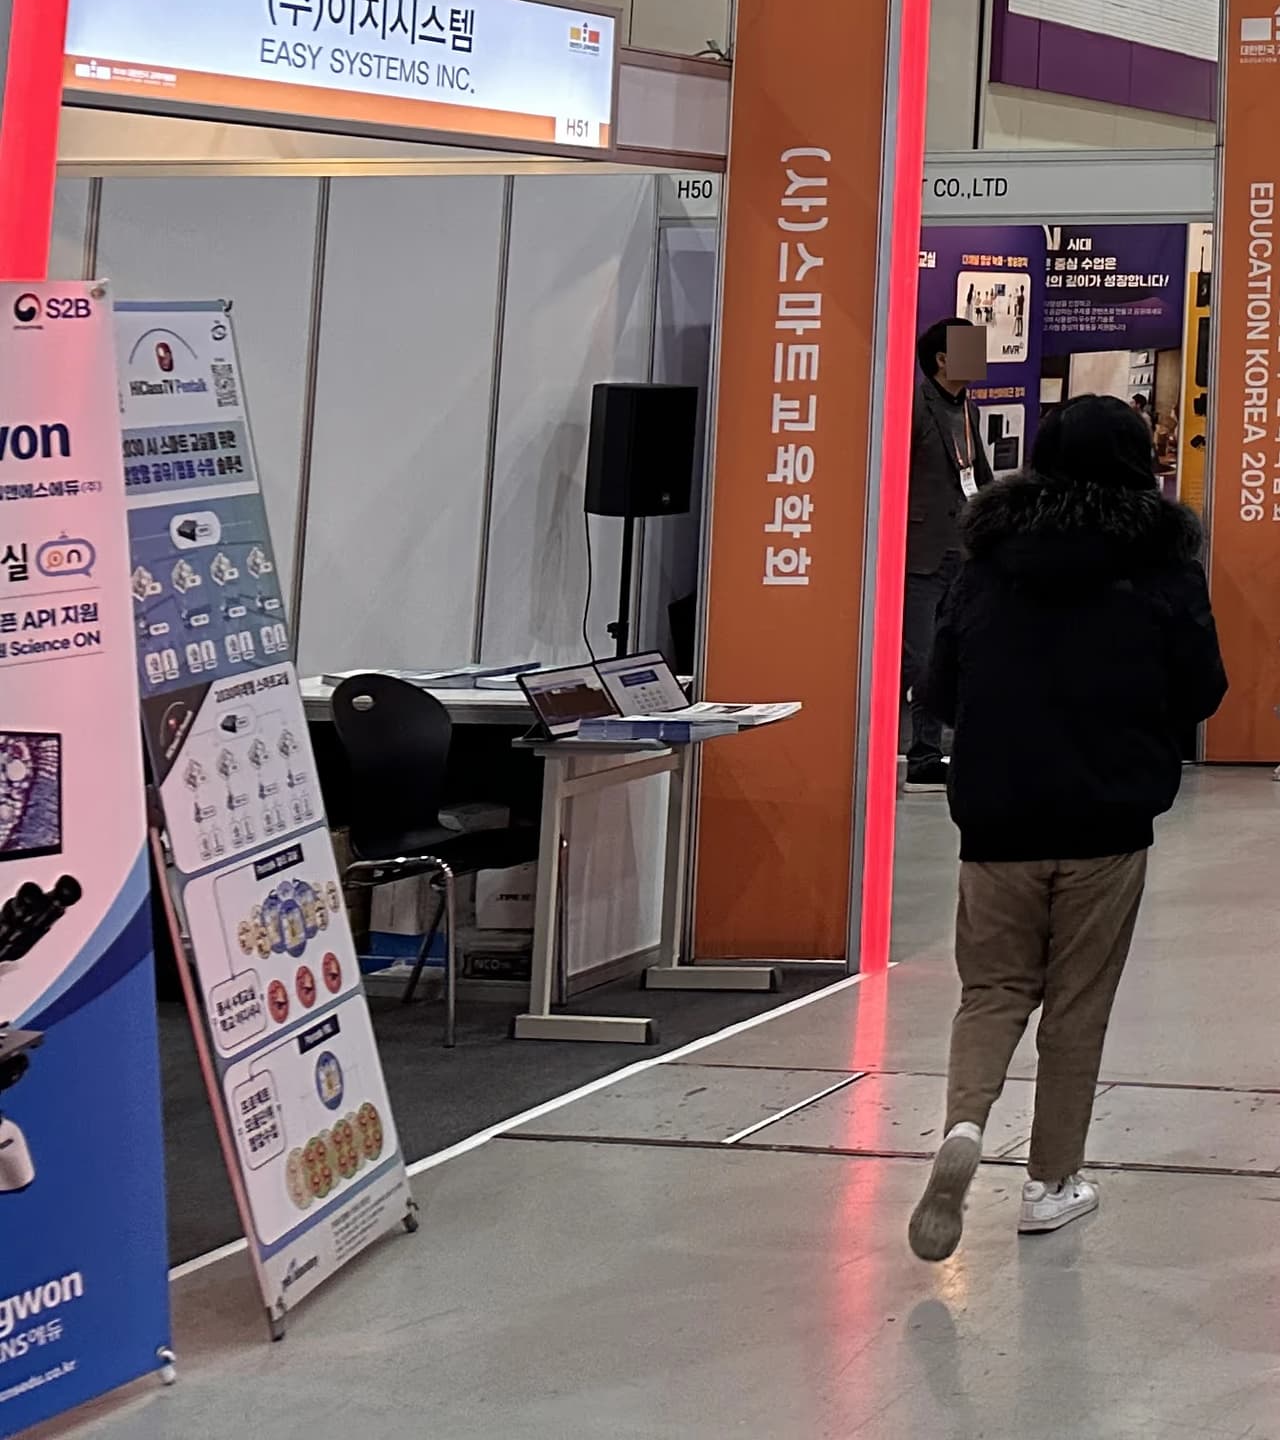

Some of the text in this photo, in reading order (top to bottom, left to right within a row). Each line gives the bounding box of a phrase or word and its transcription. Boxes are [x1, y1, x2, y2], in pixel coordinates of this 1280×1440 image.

[260, 39, 475, 94] EASY SYSTEMS INC.
[567, 118, 589, 138] H51
[677, 179, 713, 199] H50
[933, 177, 1008, 198] CO.,LTD
[1067, 238, 1092, 251] 시대
[1081, 257, 1117, 271] 수업은
[1066, 275, 1101, 288] 깊이가
[46, 298, 92, 318] S2B
[1240, 182, 1275, 522] EDUCATION KOREA 2026
[762, 146, 832, 587] (사)스마트교육학회
[22, 608, 56, 631] API
[61, 603, 99, 624] 지원
[10, 630, 101, 657] Science ON
